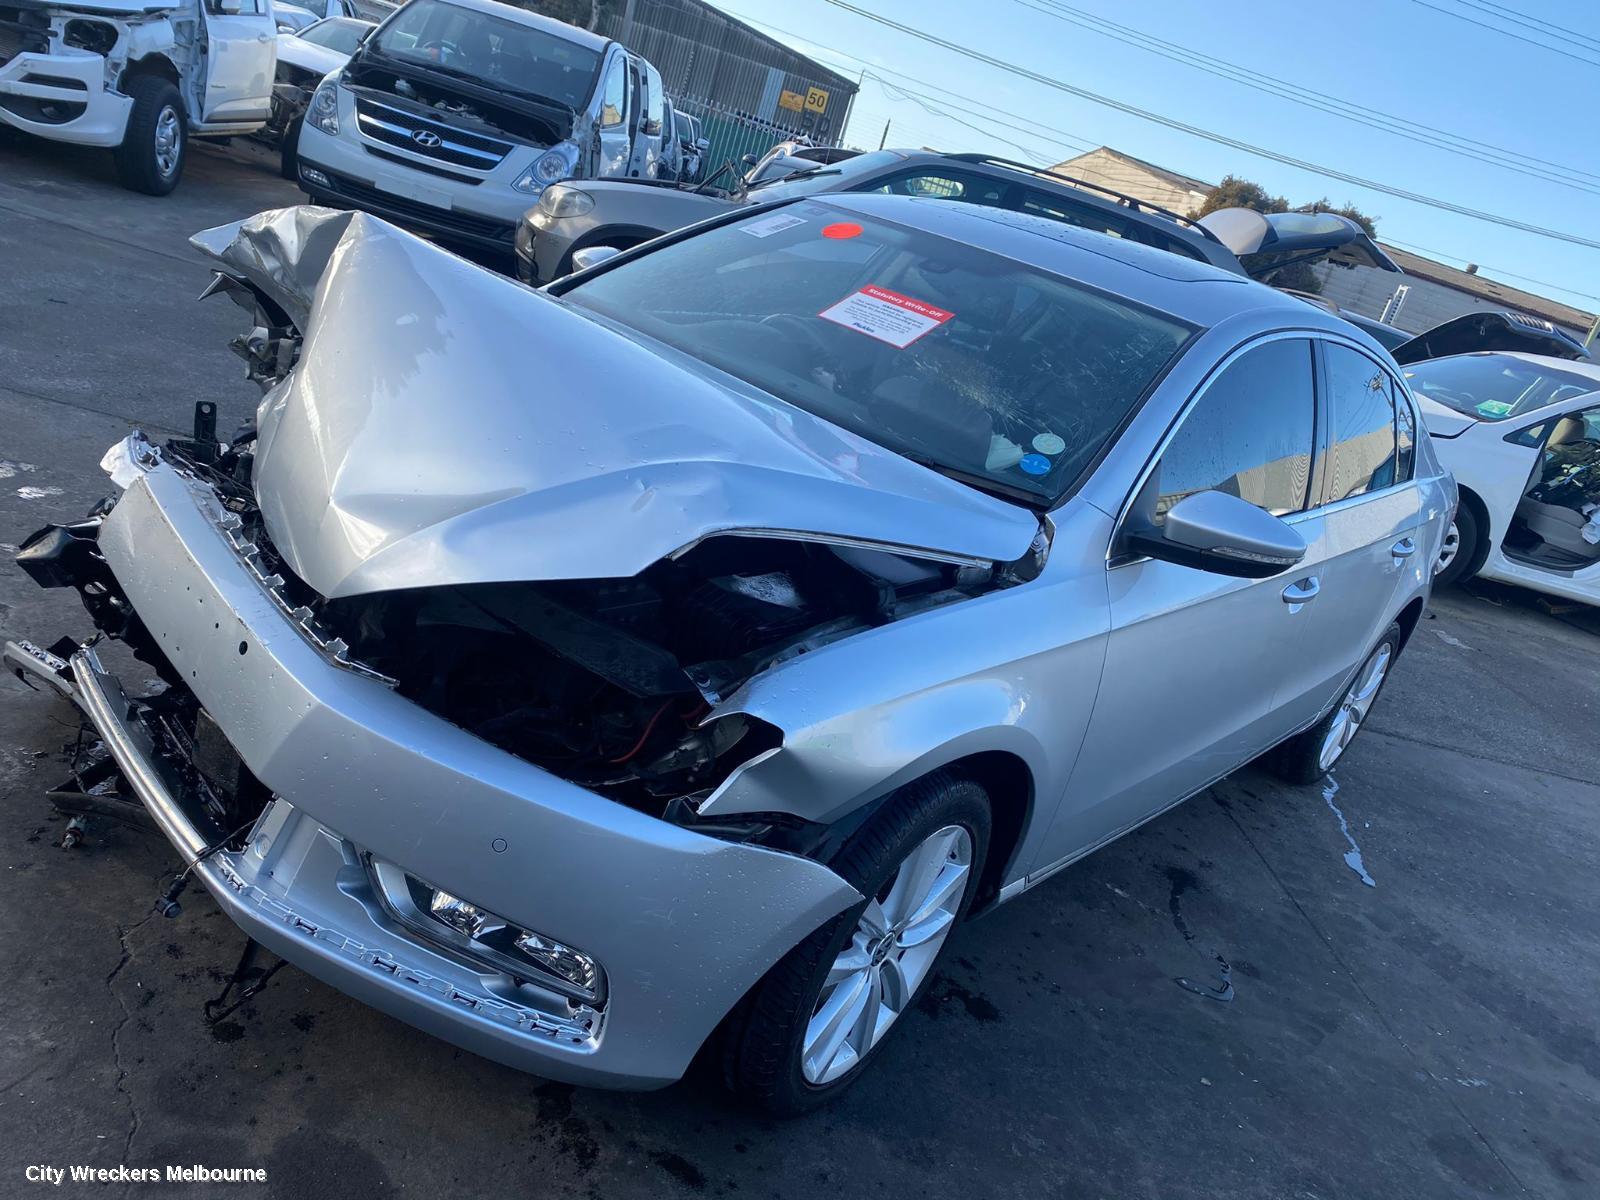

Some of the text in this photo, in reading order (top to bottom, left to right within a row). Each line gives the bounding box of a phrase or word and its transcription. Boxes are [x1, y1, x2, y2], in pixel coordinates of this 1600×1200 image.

[808, 92, 825, 108] 50
[868, 288, 903, 304] Statutory
[904, 300, 944, 318] Write-Off
